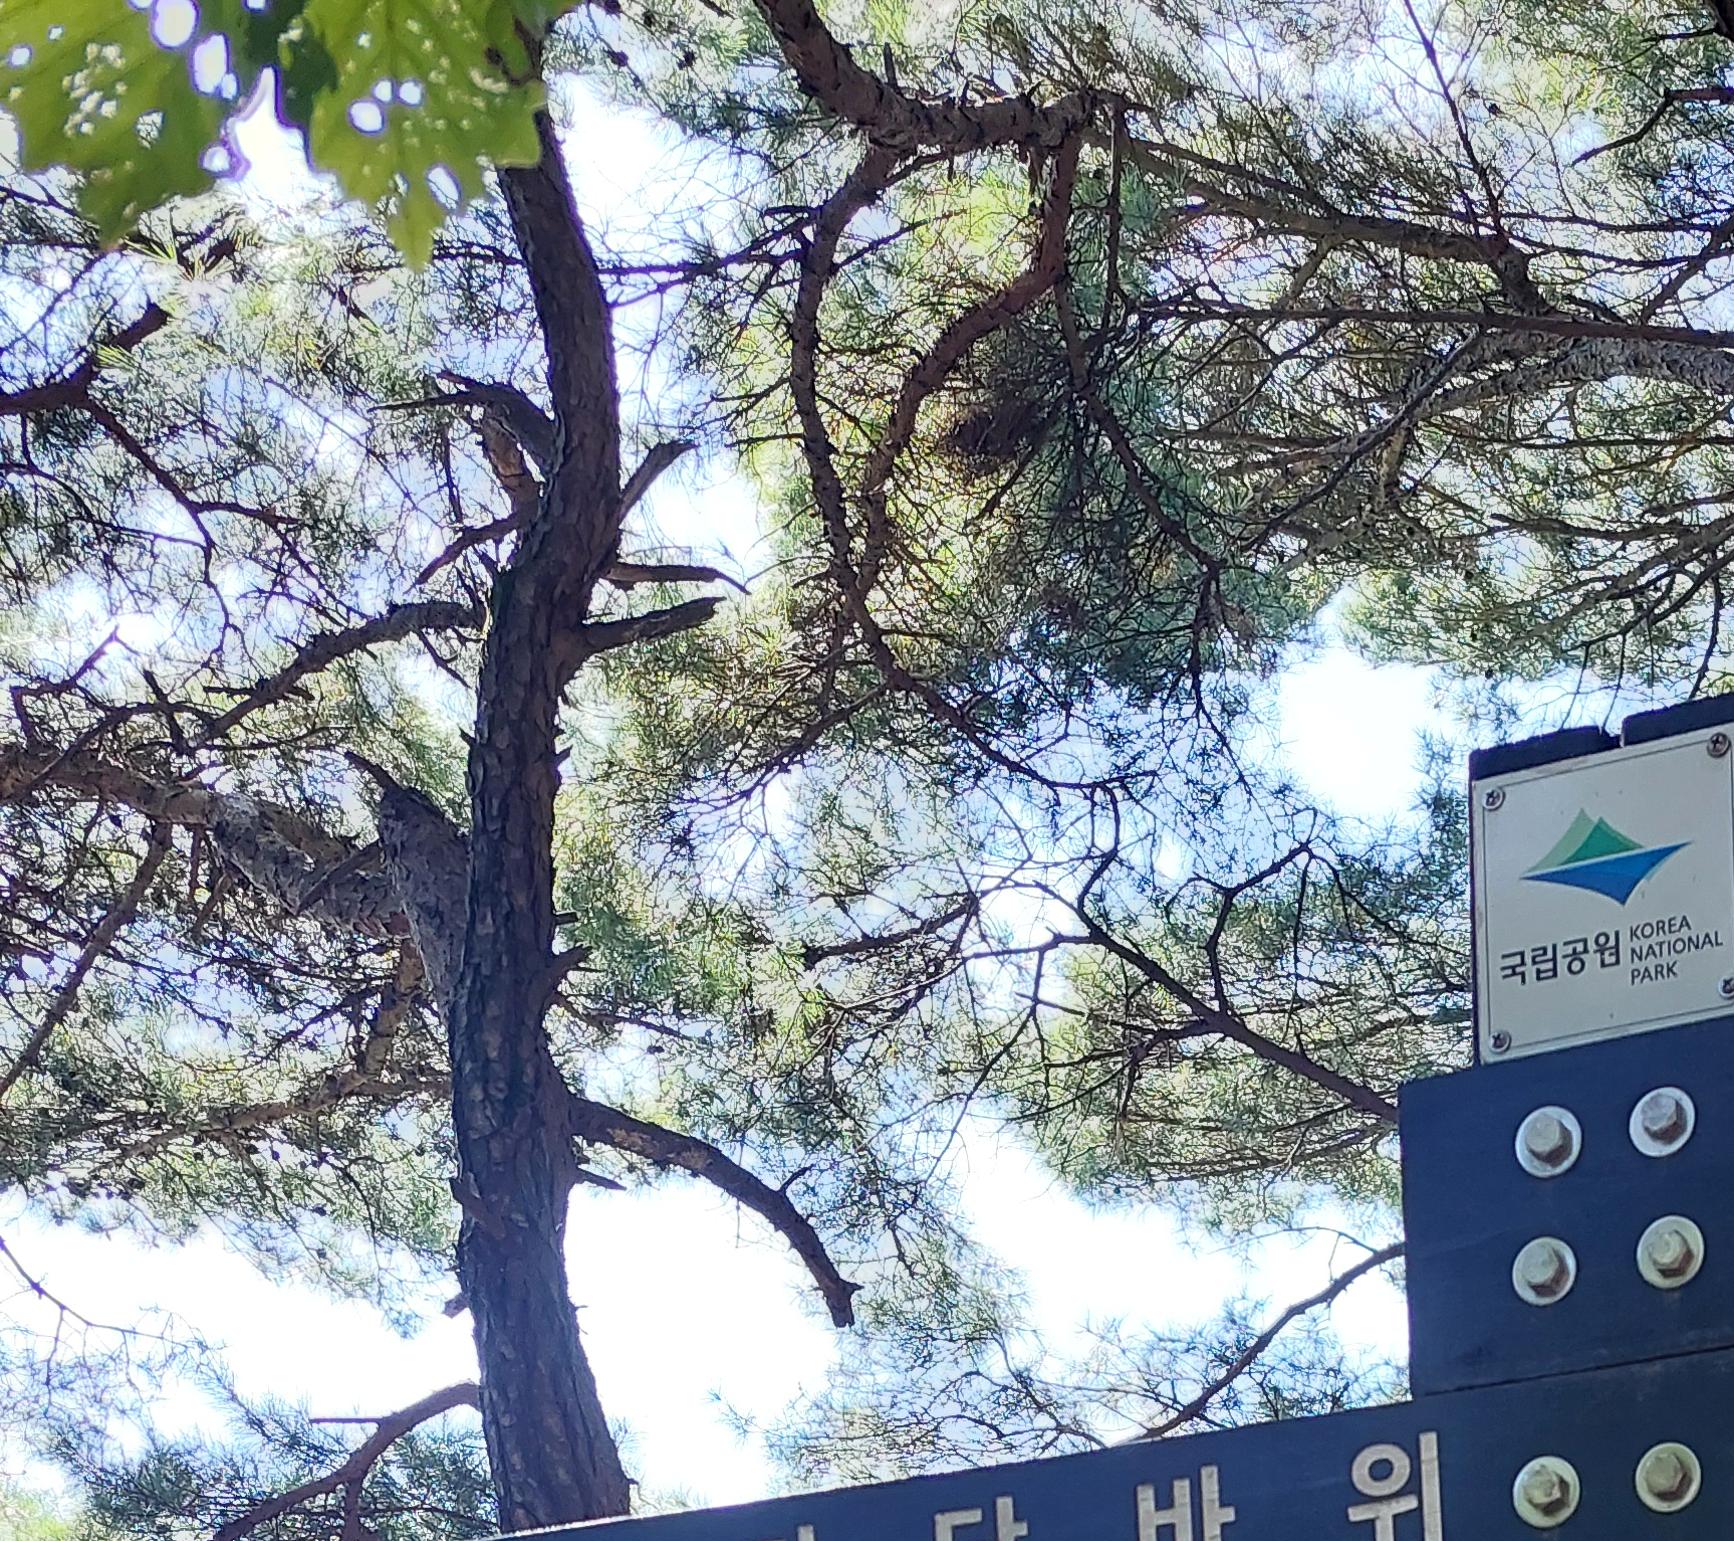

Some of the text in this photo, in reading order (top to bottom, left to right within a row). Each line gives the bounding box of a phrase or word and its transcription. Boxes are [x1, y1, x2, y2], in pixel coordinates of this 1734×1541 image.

[1629, 914, 1692, 942] KOREA
[1501, 930, 1621, 986] 국립공원
[1629, 930, 1724, 964] NATIONAL
[1630, 960, 1678, 986] PARK
